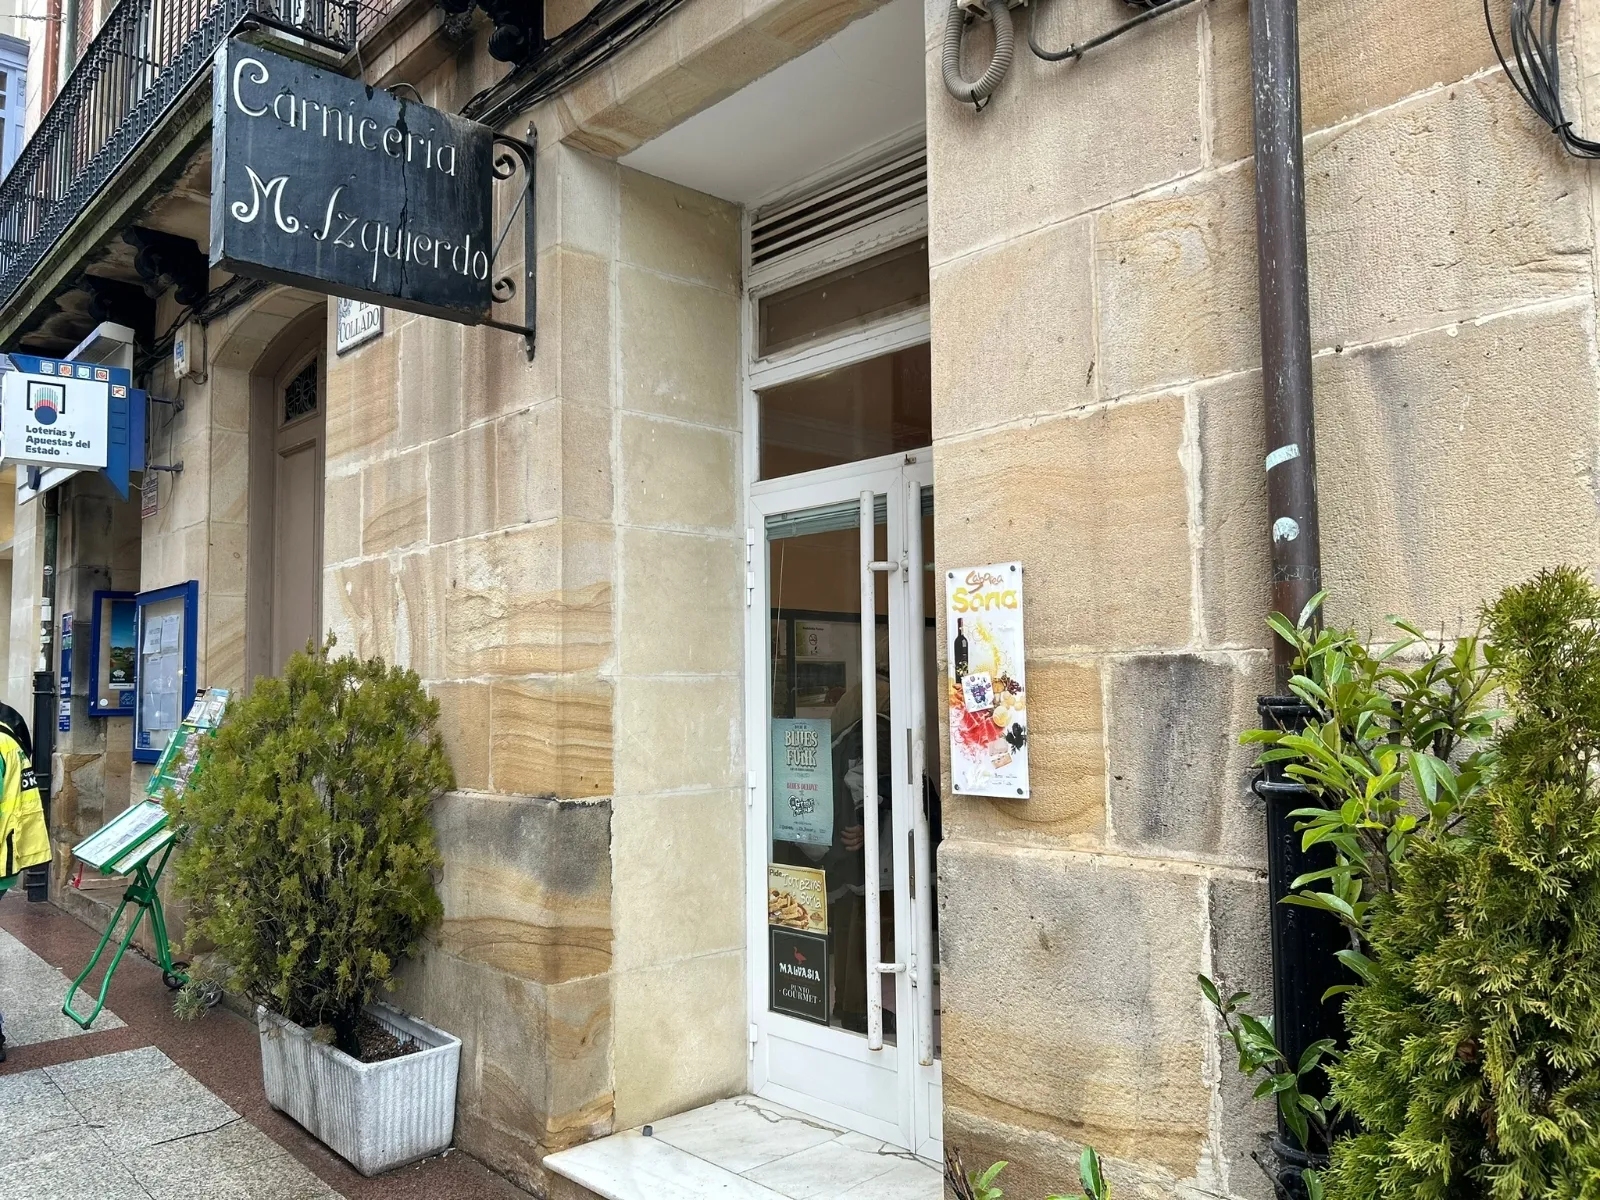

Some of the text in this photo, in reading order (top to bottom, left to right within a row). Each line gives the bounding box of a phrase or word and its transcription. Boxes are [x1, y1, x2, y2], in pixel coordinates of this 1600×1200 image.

[313, 174, 489, 283] Izquierdo
[340, 307, 380, 343] COLLADO
[25, 425, 76, 439] Loterías y
[25, 435, 91, 449] Apuestas del
[25, 445, 60, 456] Estado
[784, 730, 819, 748] BLUES
[786, 749, 818, 768] FUNK
[779, 962, 821, 982] MALVASIA
[782, 987, 819, 1004] GOURMET
